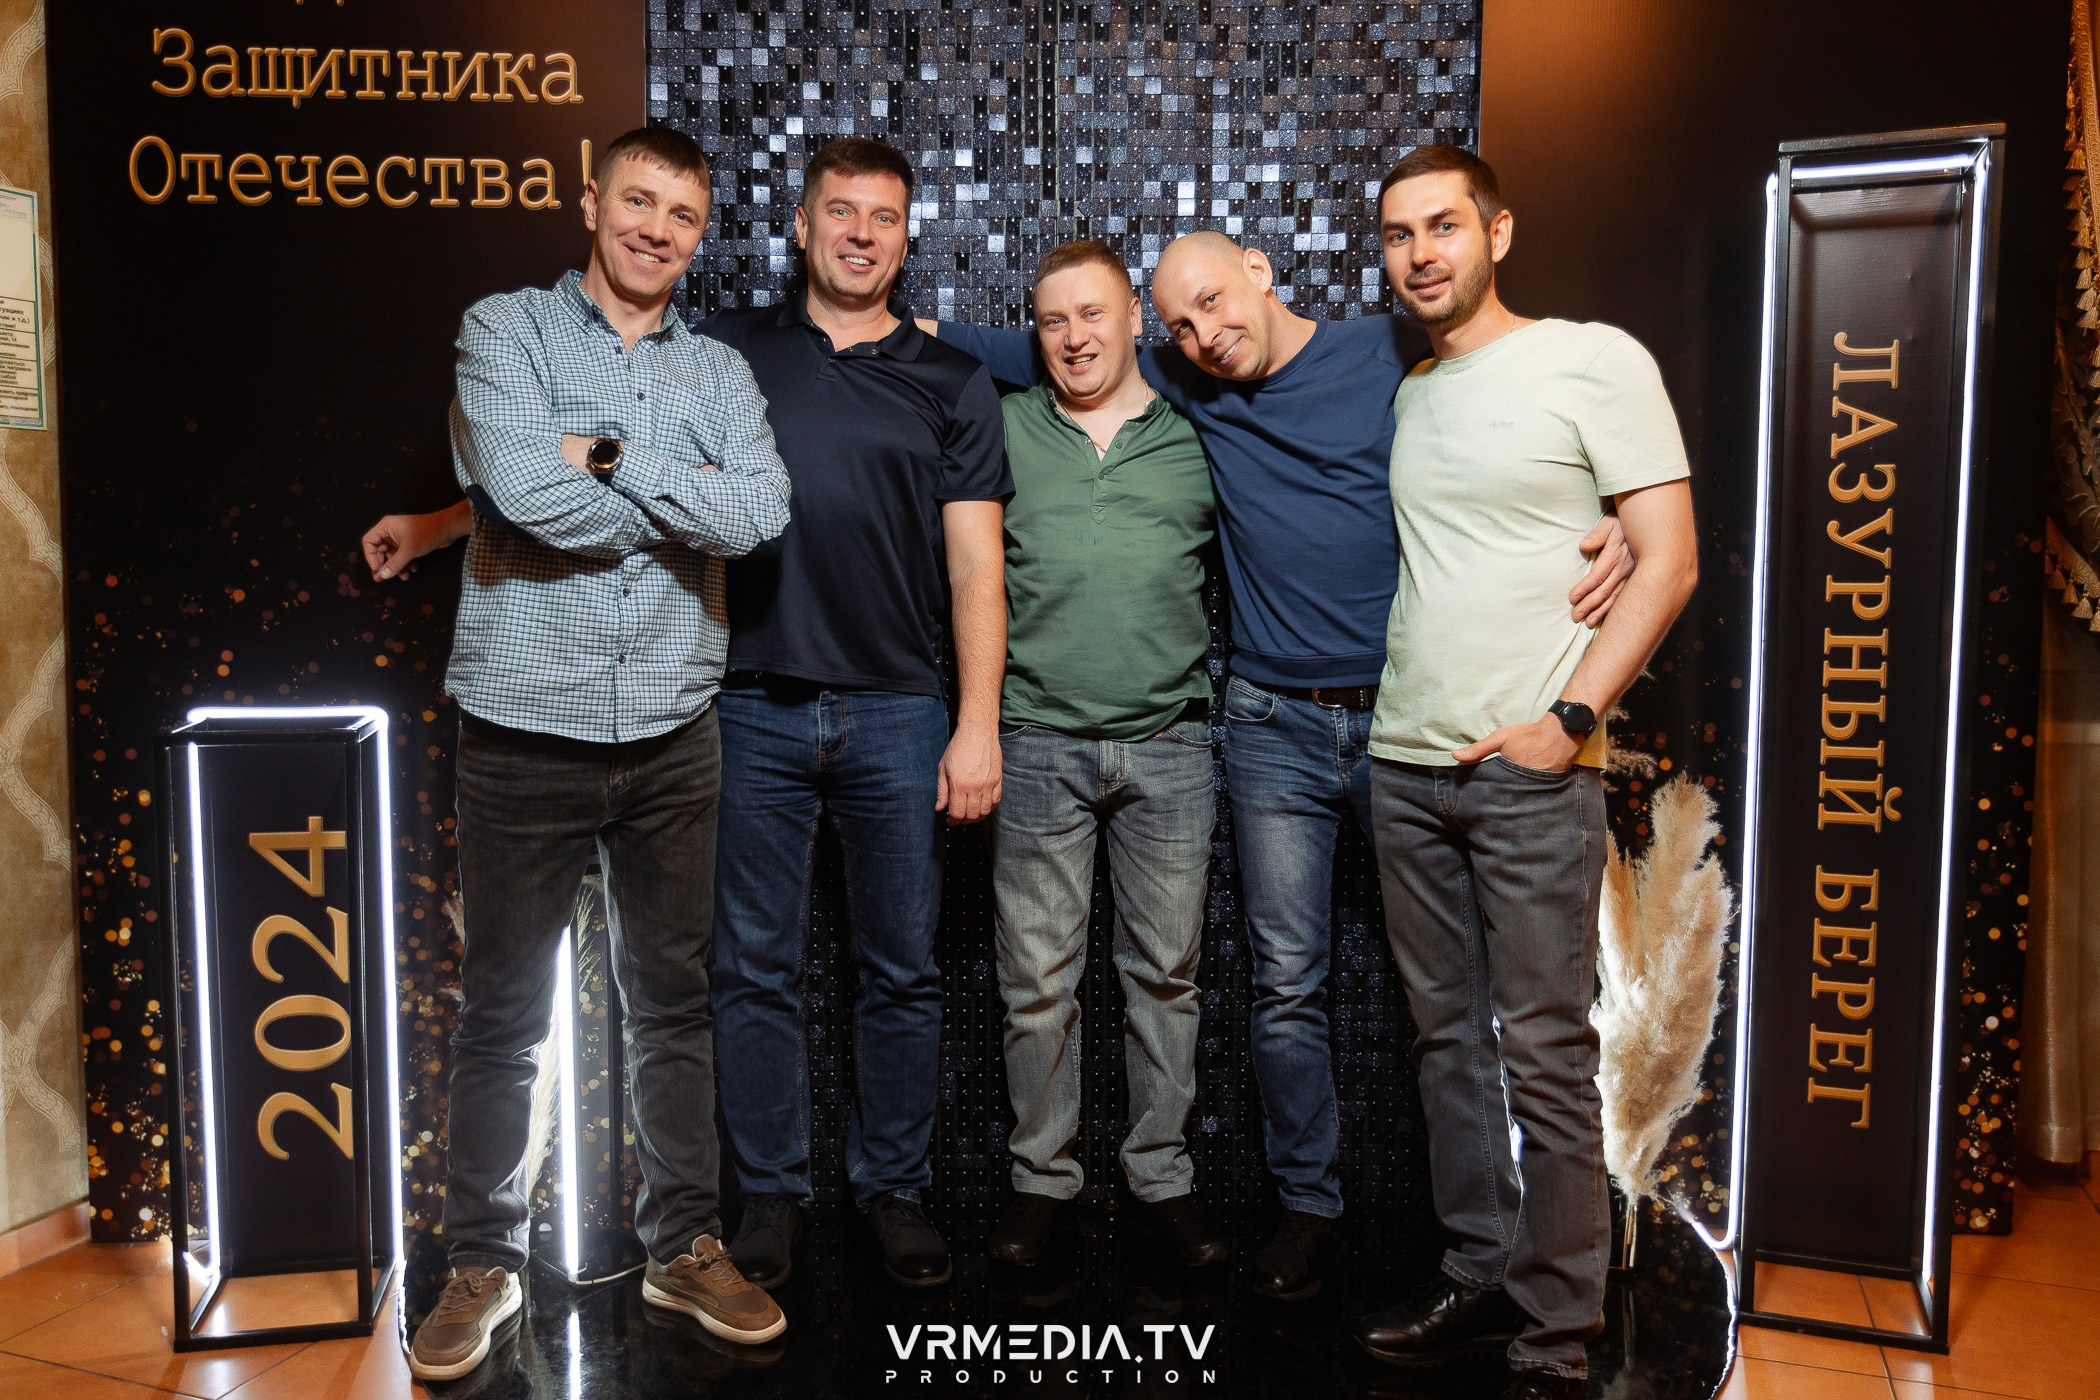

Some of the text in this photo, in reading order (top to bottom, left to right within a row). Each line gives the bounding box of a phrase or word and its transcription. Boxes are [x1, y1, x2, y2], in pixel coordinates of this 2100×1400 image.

[152, 28, 584, 107] Защитника
[1807, 332, 1901, 1129] ЛАЗУРНЫЙ БЕРЕГ
[249, 816, 354, 1160] 2024
